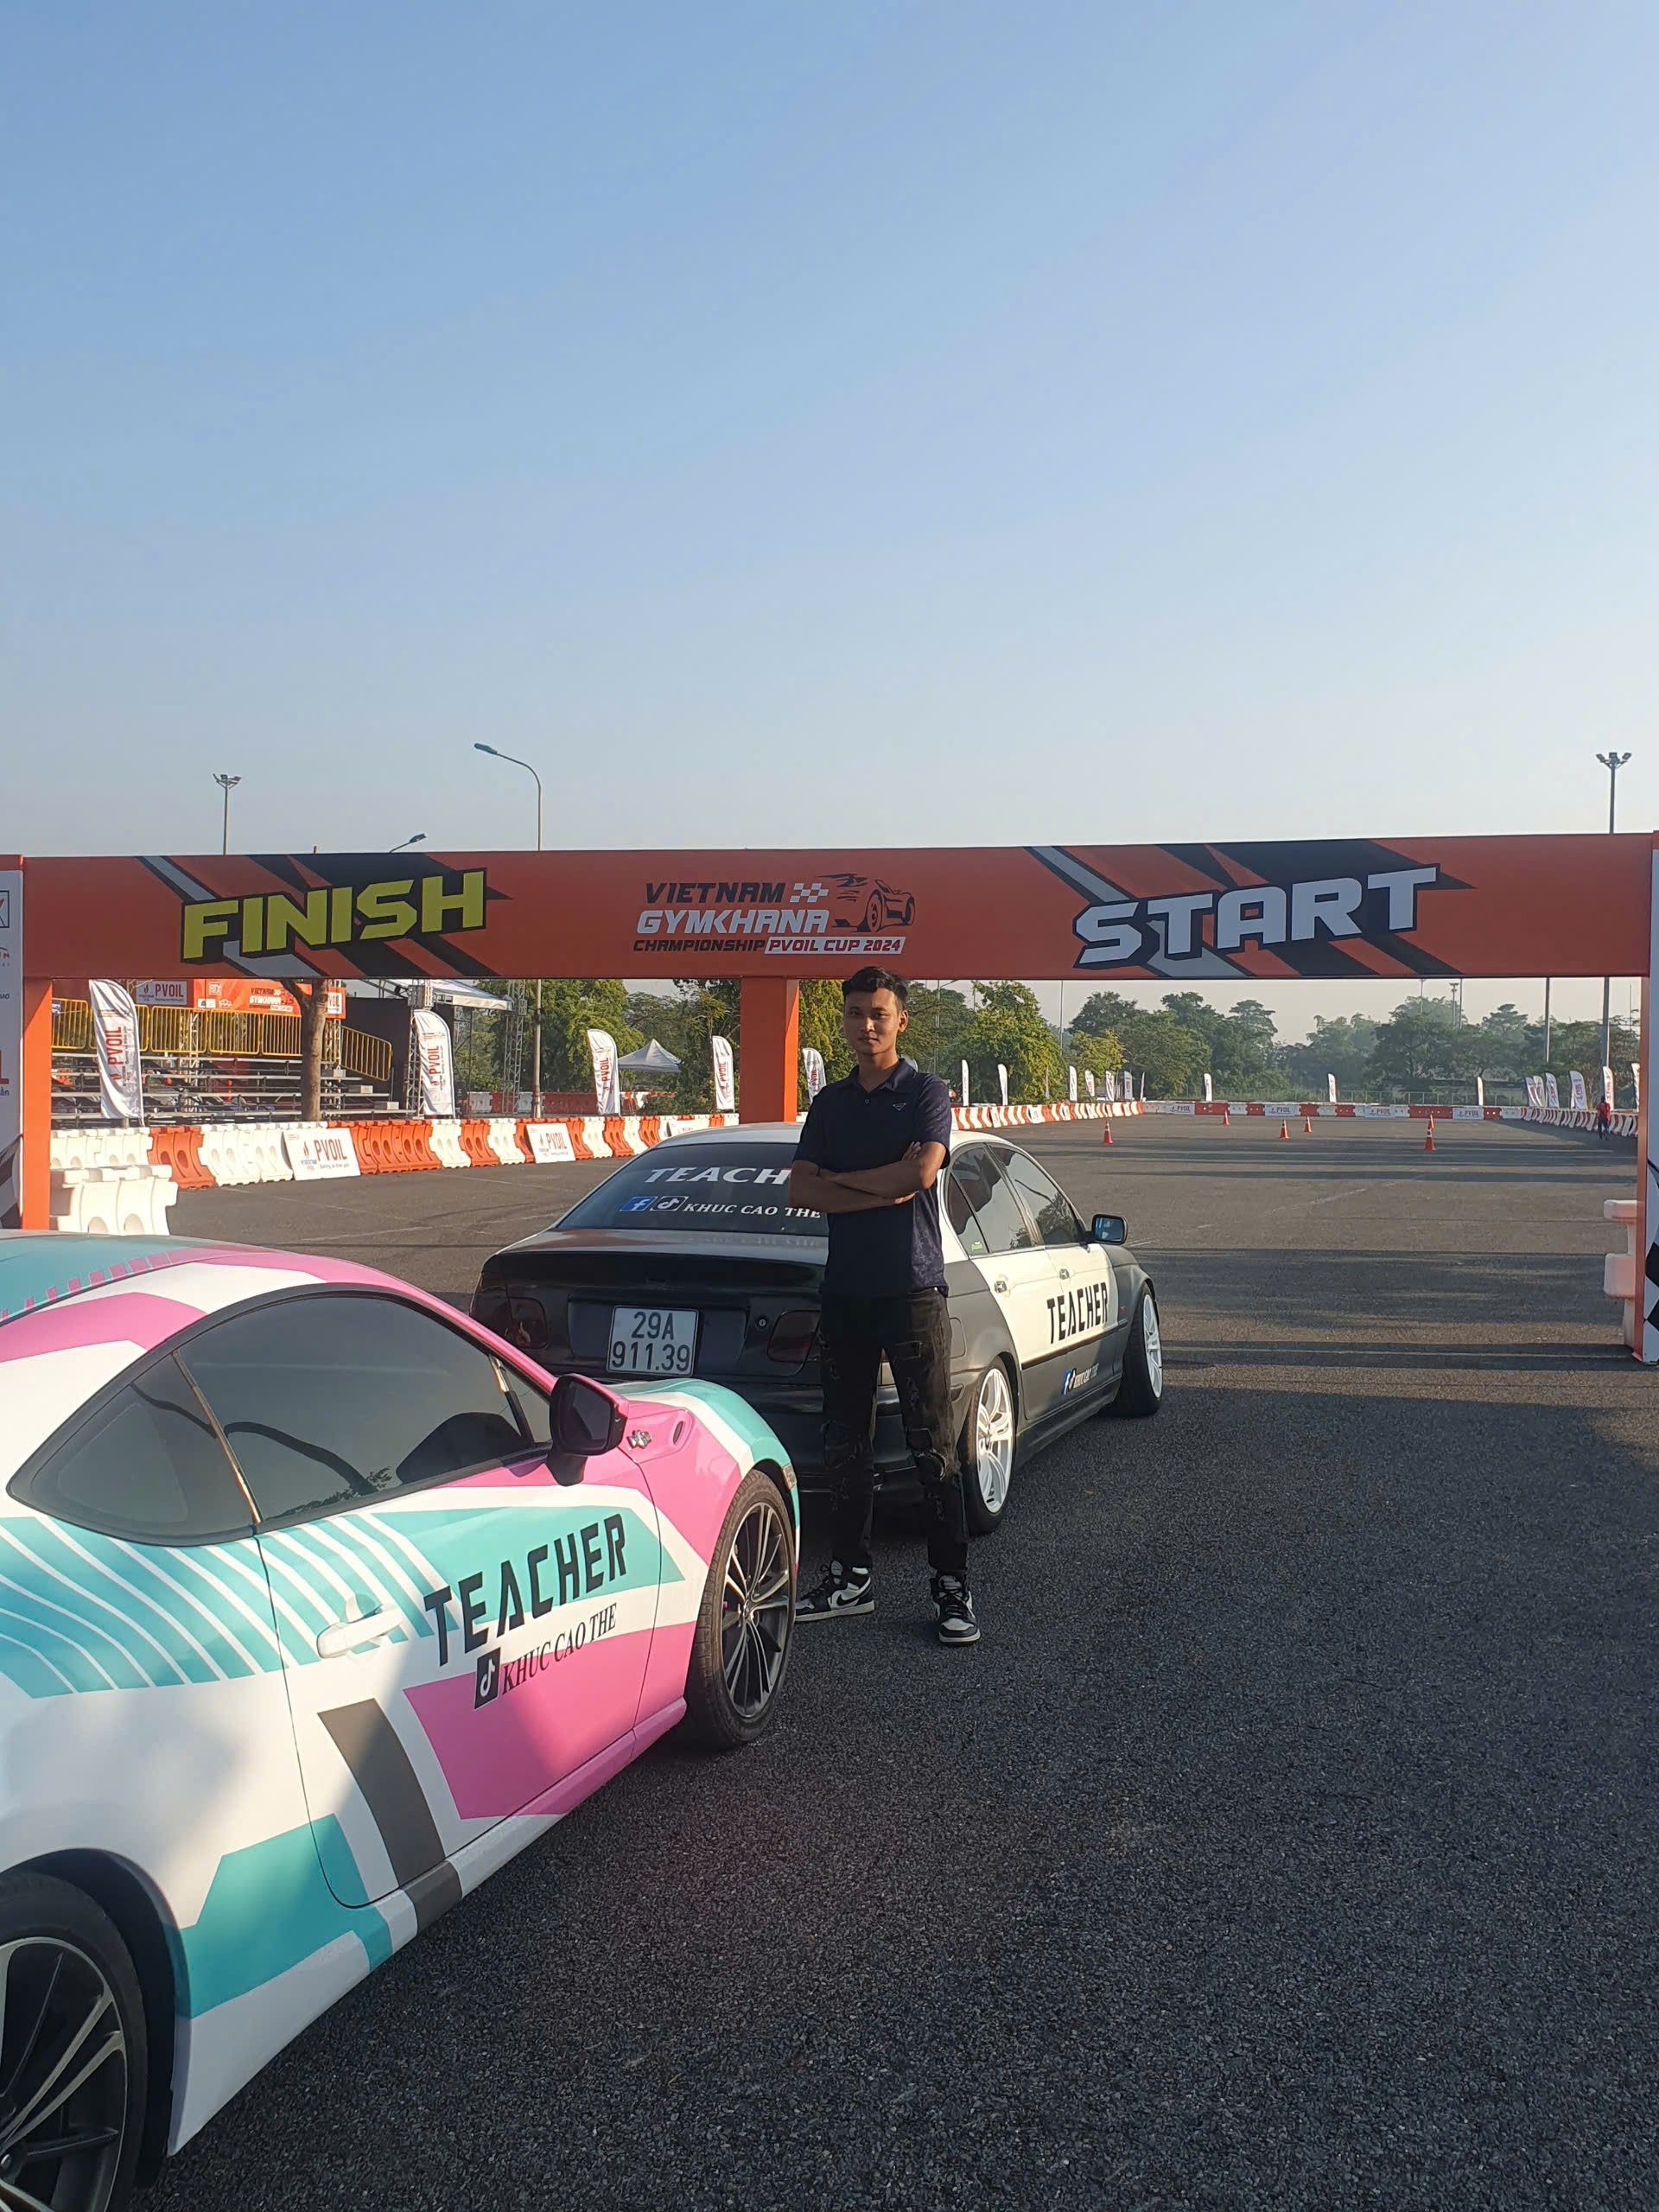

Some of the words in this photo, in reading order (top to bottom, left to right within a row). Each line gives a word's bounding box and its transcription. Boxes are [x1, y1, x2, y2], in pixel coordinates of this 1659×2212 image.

[645, 882, 785, 903] VIETNAM
[183, 871, 485, 960] FINISH
[637, 909, 830, 934] GYMKHANA
[1075, 867, 1437, 965] START
[633, 939, 766, 951] CHAMPIONSHIP
[768, 939, 818, 951] PVOIL
[823, 939, 859, 951] CUP
[863, 939, 900, 951] 2024
[155, 983, 184, 997] PVOIL
[105, 1027, 124, 1065] PVOIL
[428, 1046, 442, 1075] PVOIL
[600, 1057, 610, 1082] PVOIL
[314, 1138, 347, 1161] PVOIL
[645, 1167, 793, 1185] TEACH
[683, 1202, 737, 1214] KHUC
[741, 1205, 779, 1216] CAO
[784, 1206, 821, 1218] THE
[631, 1311, 674, 1340] 29A
[1046, 1281, 1108, 1344] TEACHER
[612, 1341, 690, 1372] 911.39
[423, 1514, 626, 1667] TEACHER
[502, 1642, 551, 1695] KHUC
[554, 1621, 586, 1662] CAO
[589, 1603, 617, 1643] THE
